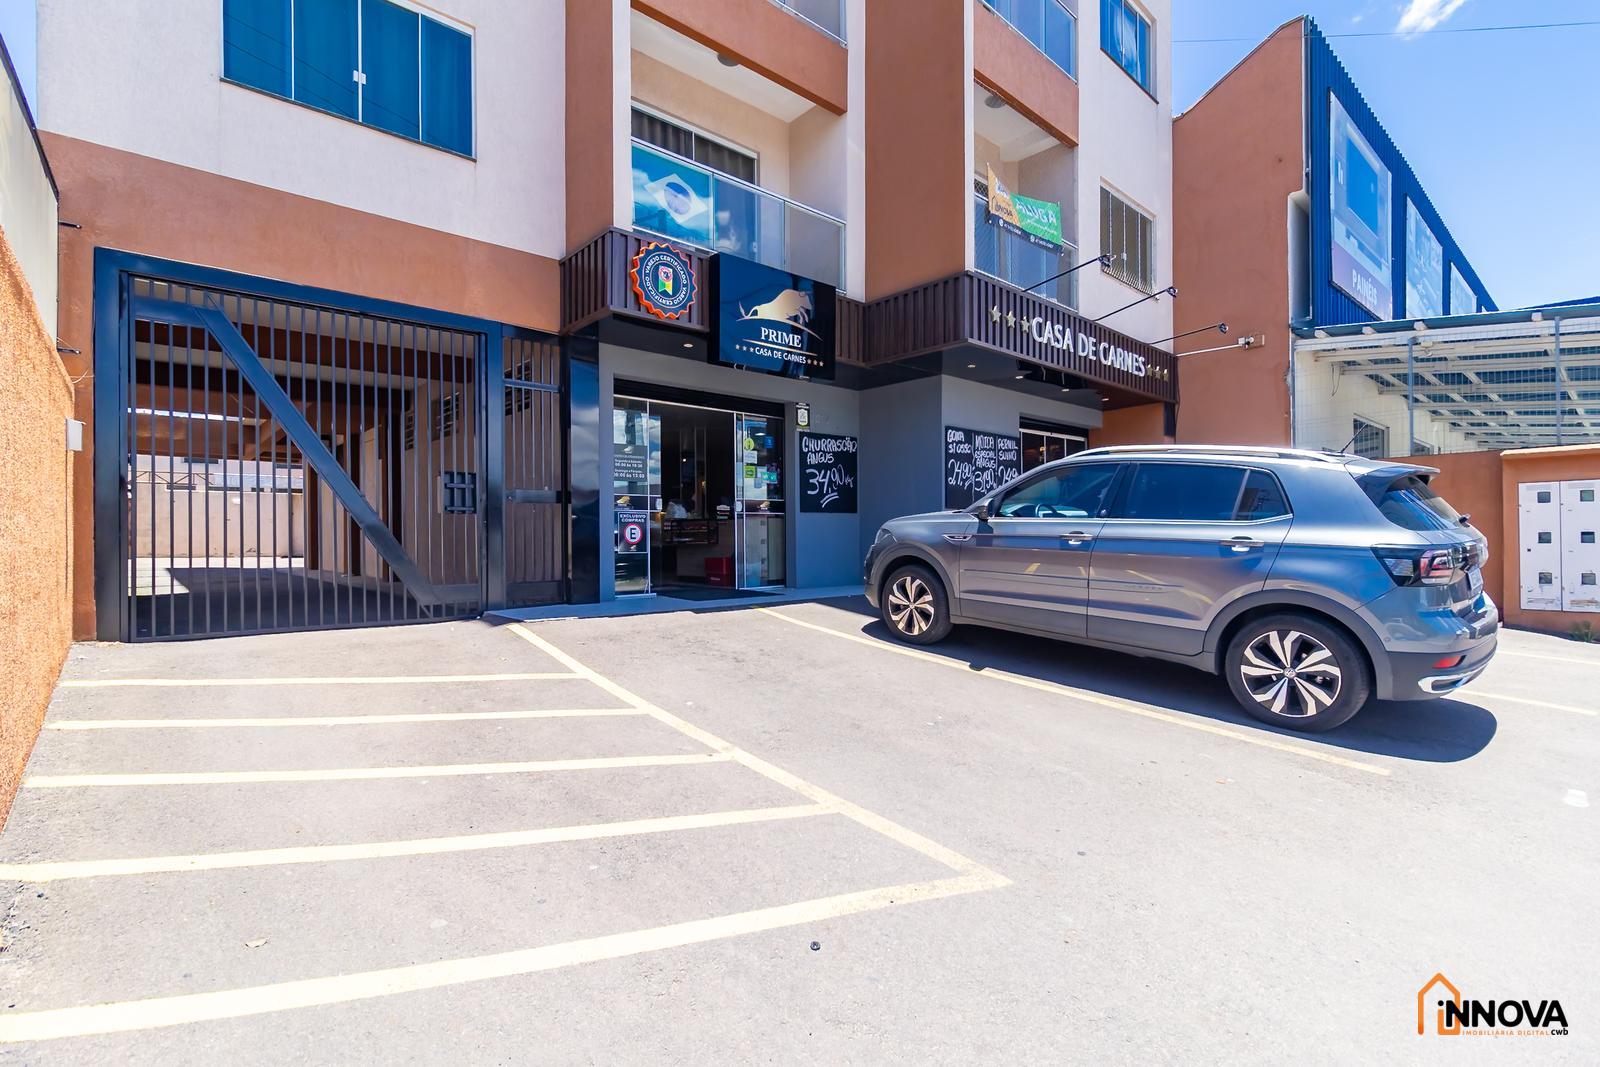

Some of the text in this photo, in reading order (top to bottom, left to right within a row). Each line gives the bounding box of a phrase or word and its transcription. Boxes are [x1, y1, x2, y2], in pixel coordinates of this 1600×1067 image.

[645, 254, 688, 285] VAREJO CERTIFICADO
[1352, 268, 1378, 306] PAINÉIS
[760, 326, 802, 348] PRIME
[1031, 316, 1146, 377] CASA DE CARNES
[755, 346, 807, 364] CASA DE CARNES
[807, 452, 834, 465] ANGUS
[630, 527, 637, 540] E
